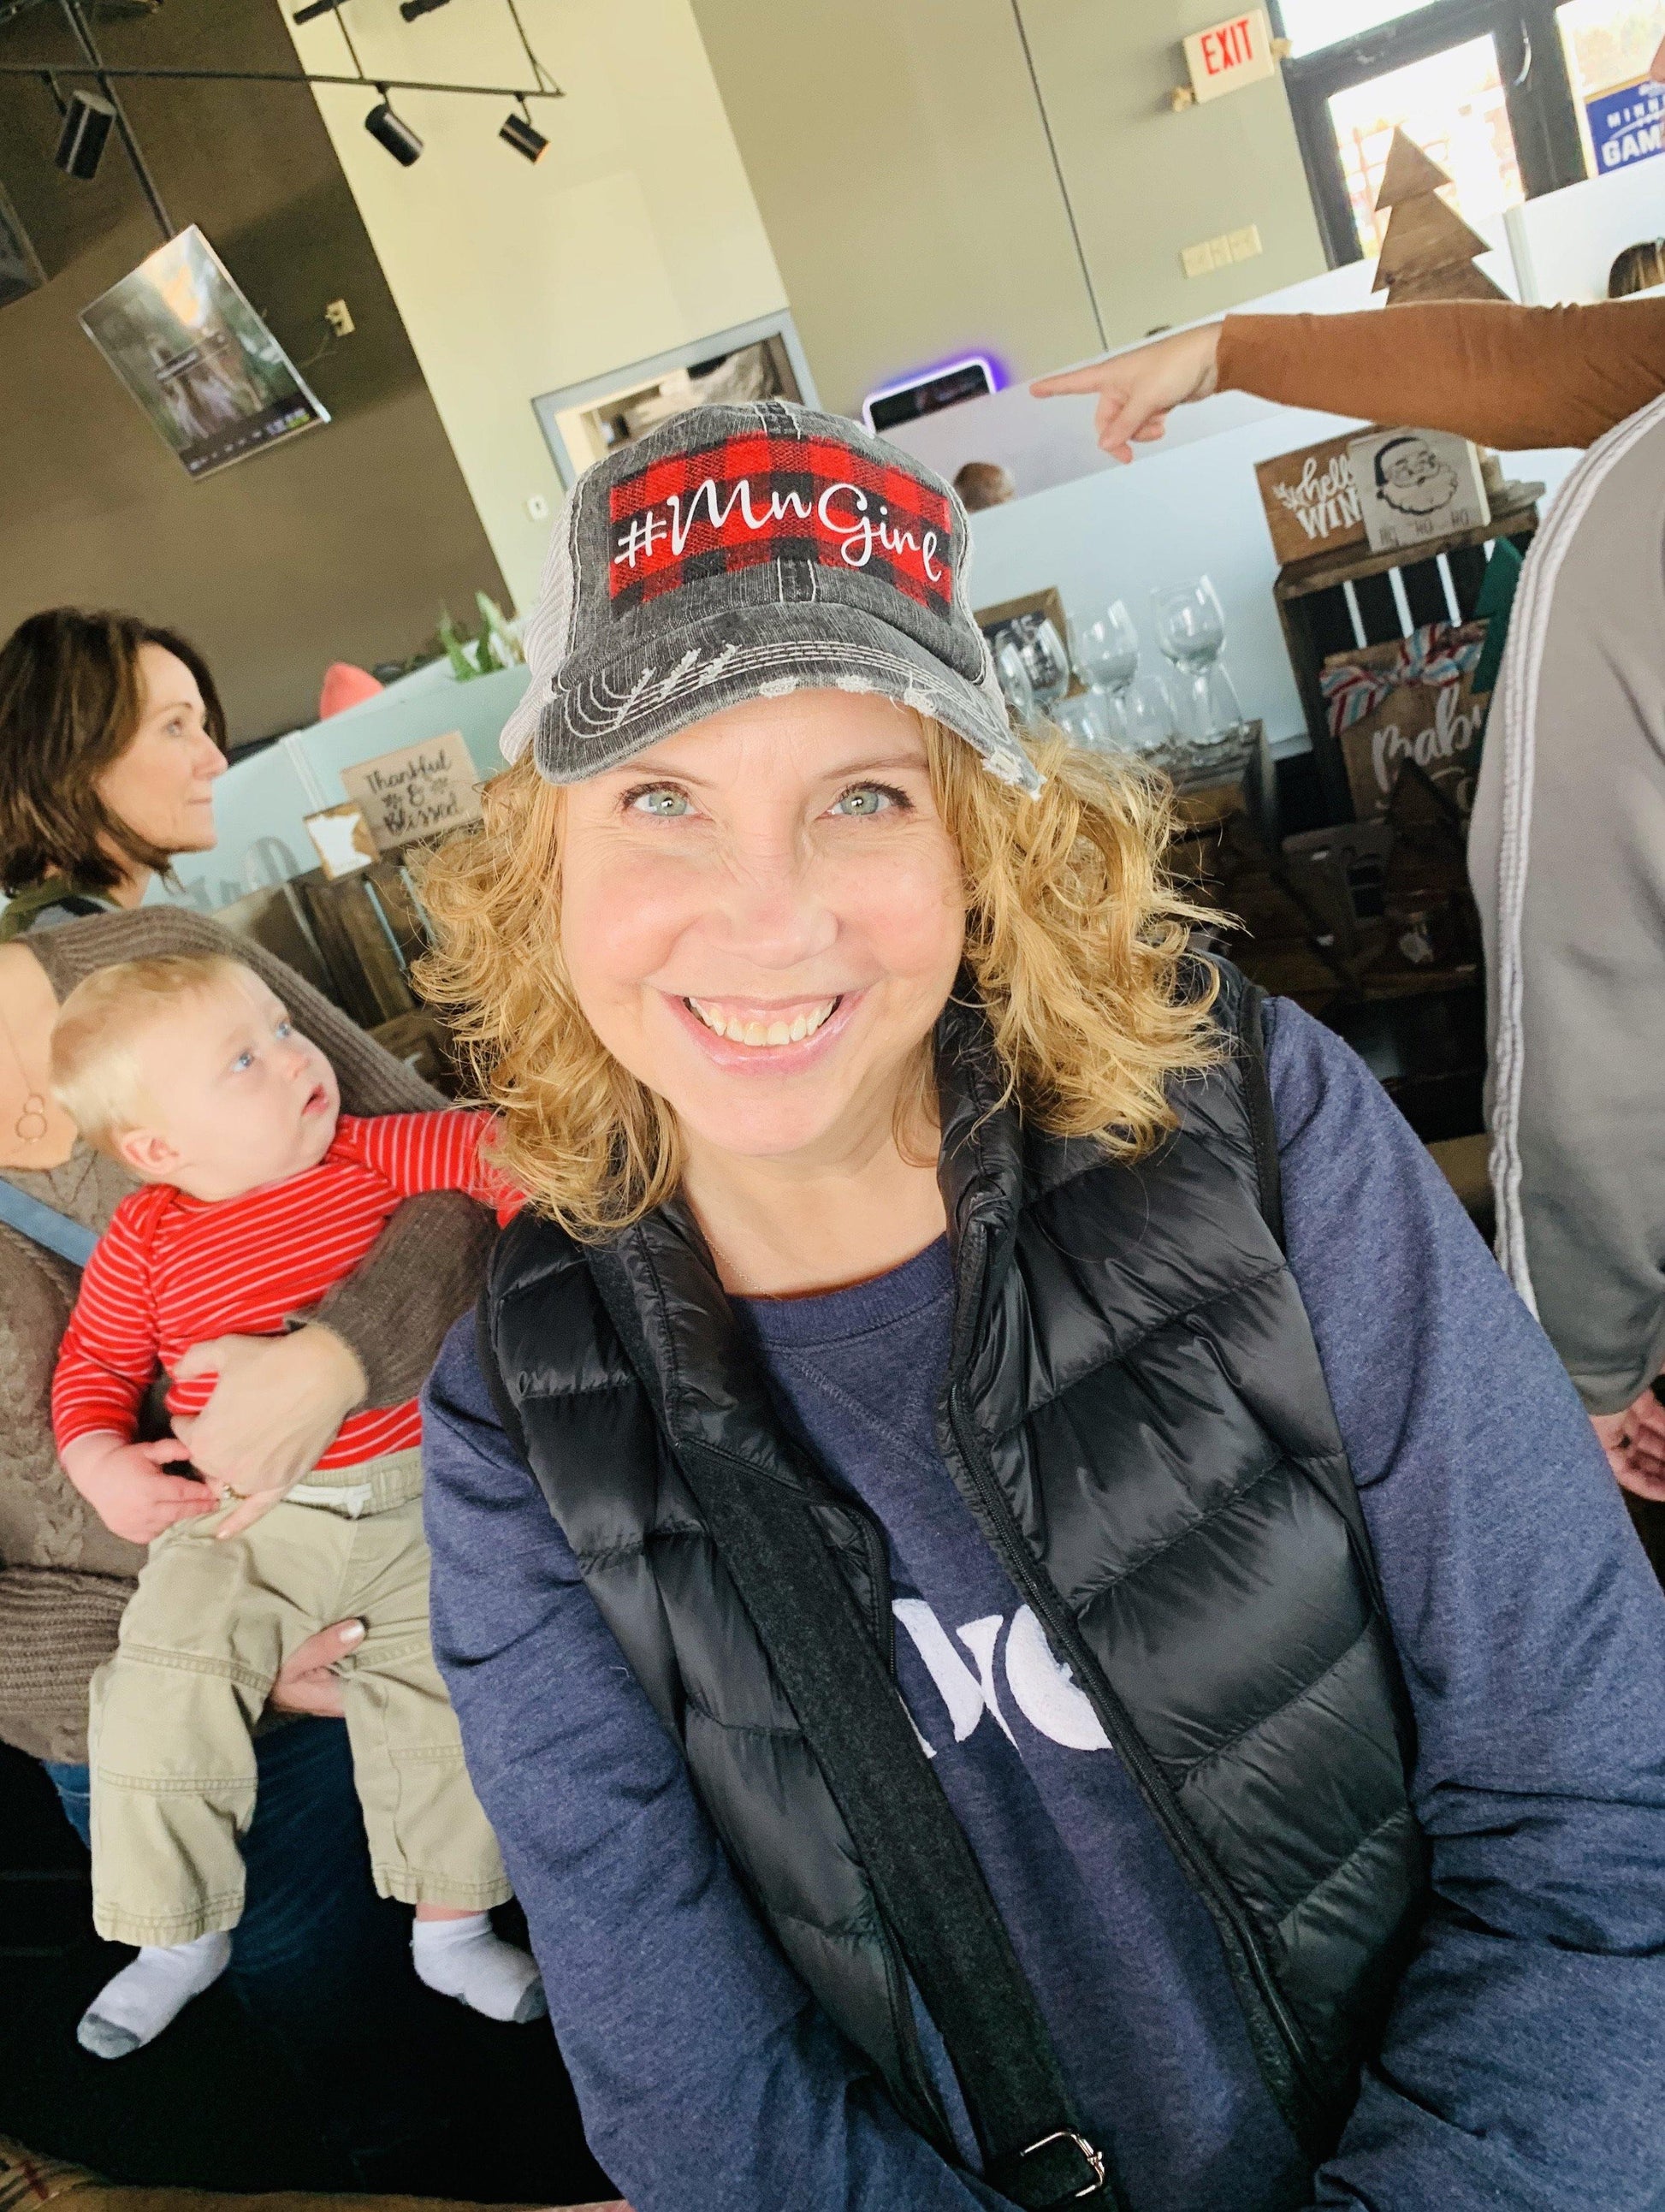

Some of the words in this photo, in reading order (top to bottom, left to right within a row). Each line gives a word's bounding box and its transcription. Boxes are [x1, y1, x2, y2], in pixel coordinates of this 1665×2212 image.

[1200, 19, 1253, 75] EXIT
[1606, 94, 1665, 129] MINN
[1600, 123, 1663, 168] GAM
[1293, 453, 1357, 507] hell
[613, 478, 943, 583] #MnGirl
[1296, 486, 1363, 541] WIN
[1372, 685, 1482, 795] Bab
[364, 747, 452, 795] Thankful
